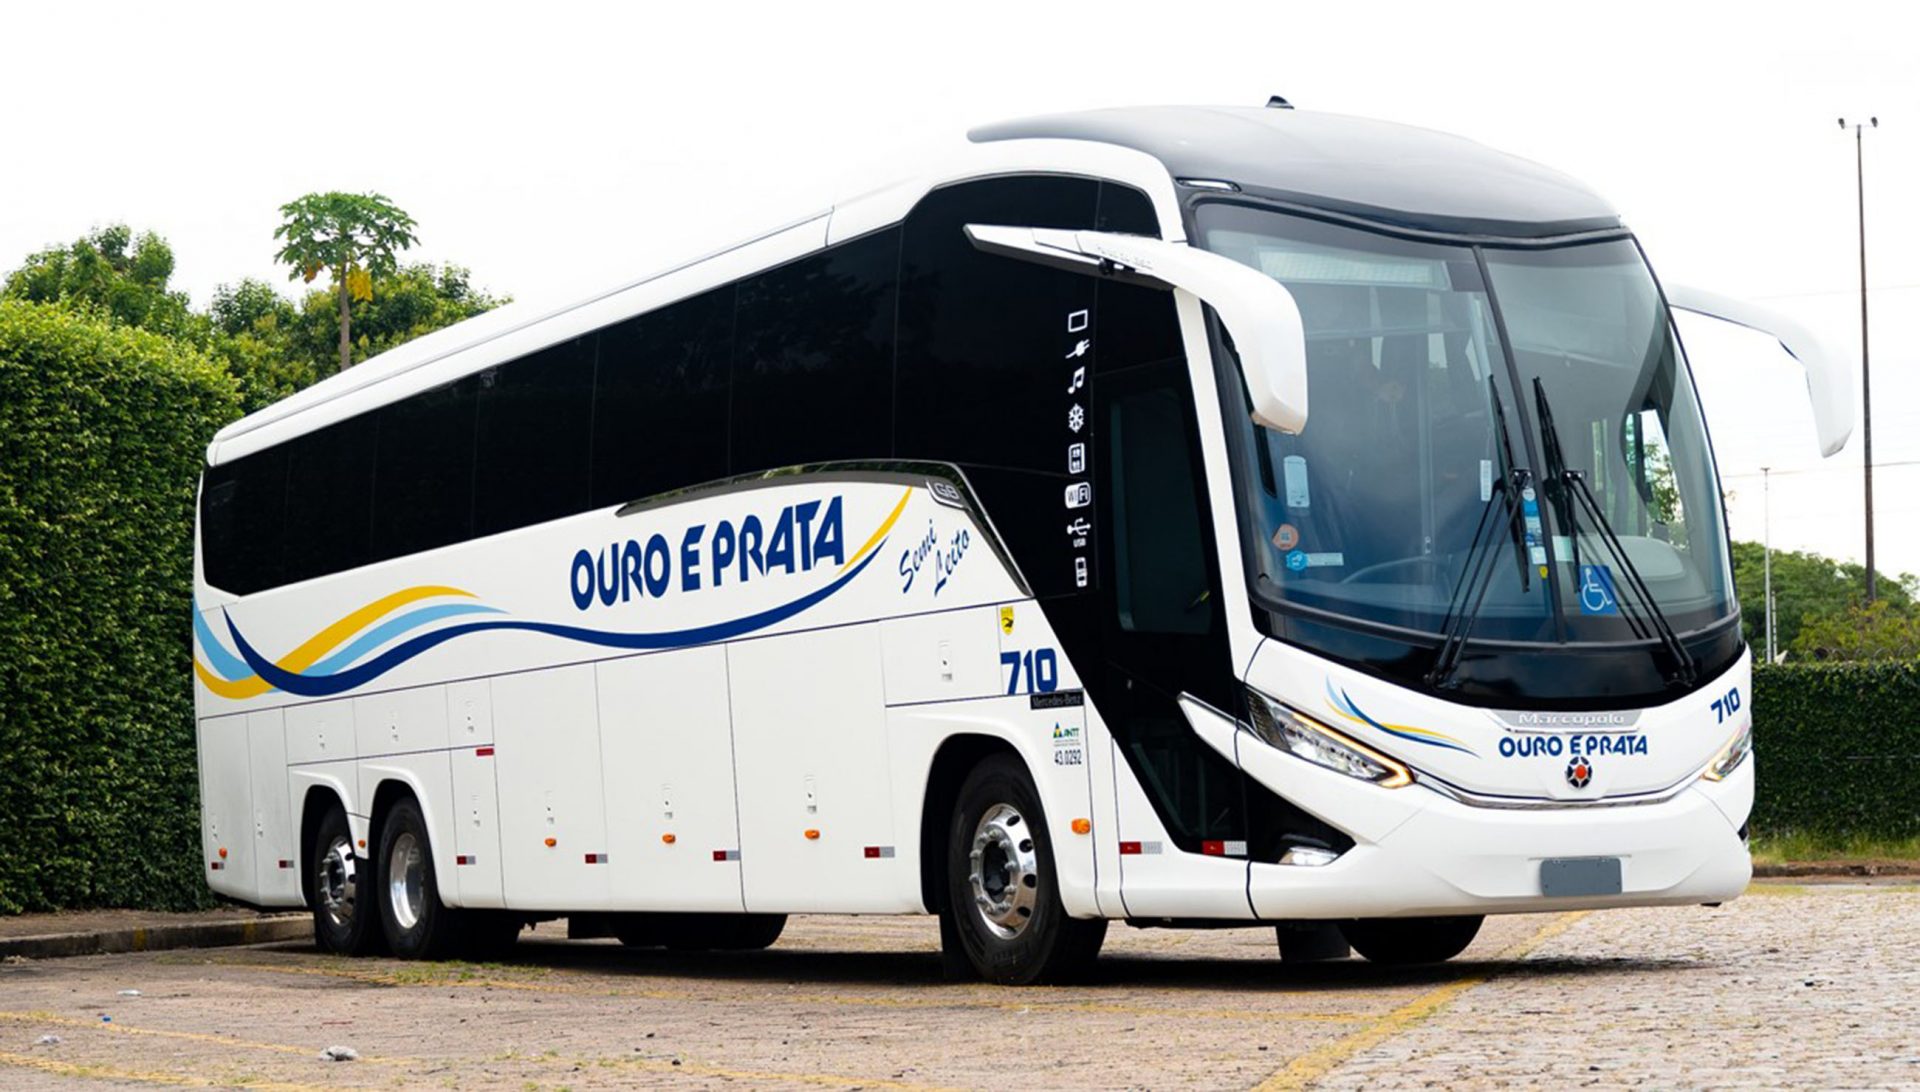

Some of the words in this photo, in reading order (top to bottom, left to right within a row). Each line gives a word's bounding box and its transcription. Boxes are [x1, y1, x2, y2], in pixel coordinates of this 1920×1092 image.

[570, 533, 671, 611] OURO
[680, 524, 706, 592] E
[711, 495, 845, 587] PRATA
[899, 518, 937, 594] Semi
[934, 529, 970, 597] Leito
[1001, 648, 1058, 695] 710
[1518, 712, 1625, 726] Marcopolo
[1710, 687, 1741, 724] 710
[1499, 736, 1563, 757] OURO
[1570, 735, 1583, 756] E
[1586, 735, 1648, 756] PRATA
